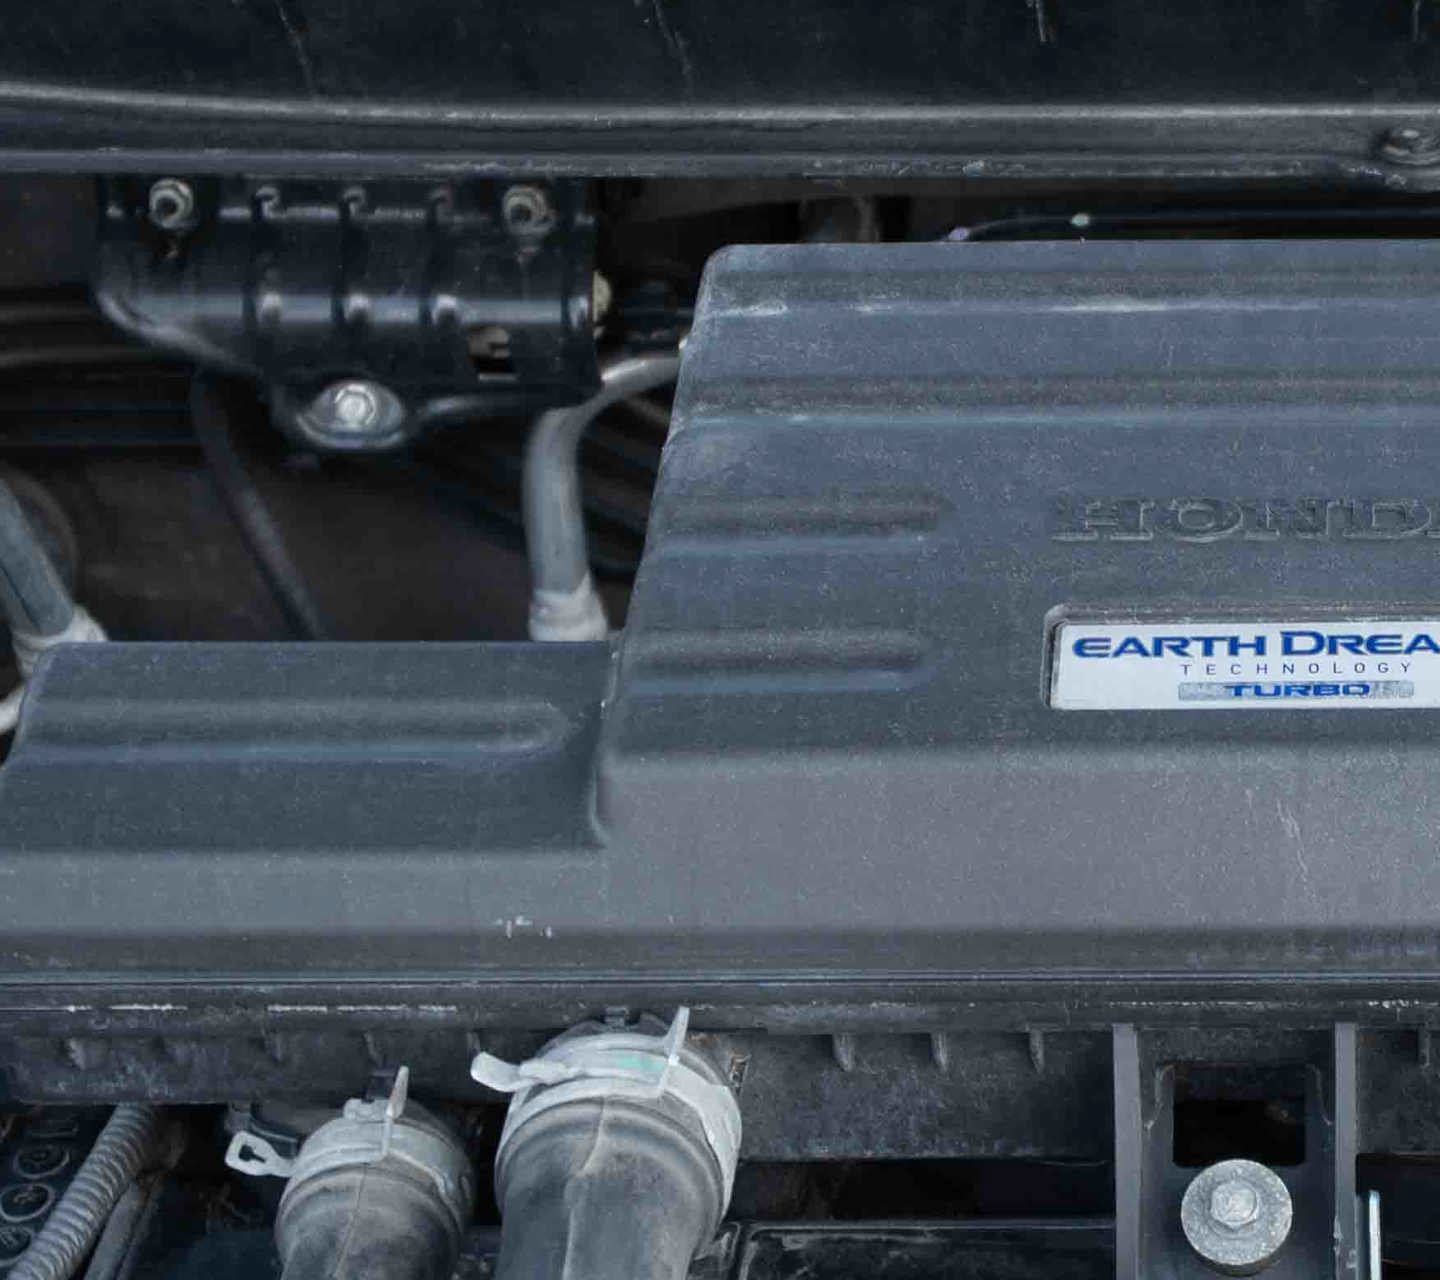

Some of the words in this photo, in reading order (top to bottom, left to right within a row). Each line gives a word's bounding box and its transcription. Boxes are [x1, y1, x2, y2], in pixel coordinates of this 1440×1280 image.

[1072, 631, 1267, 659] EARTH
[1178, 660, 1414, 677] TECHNOLOGY
[1224, 681, 1373, 699] TURBO
